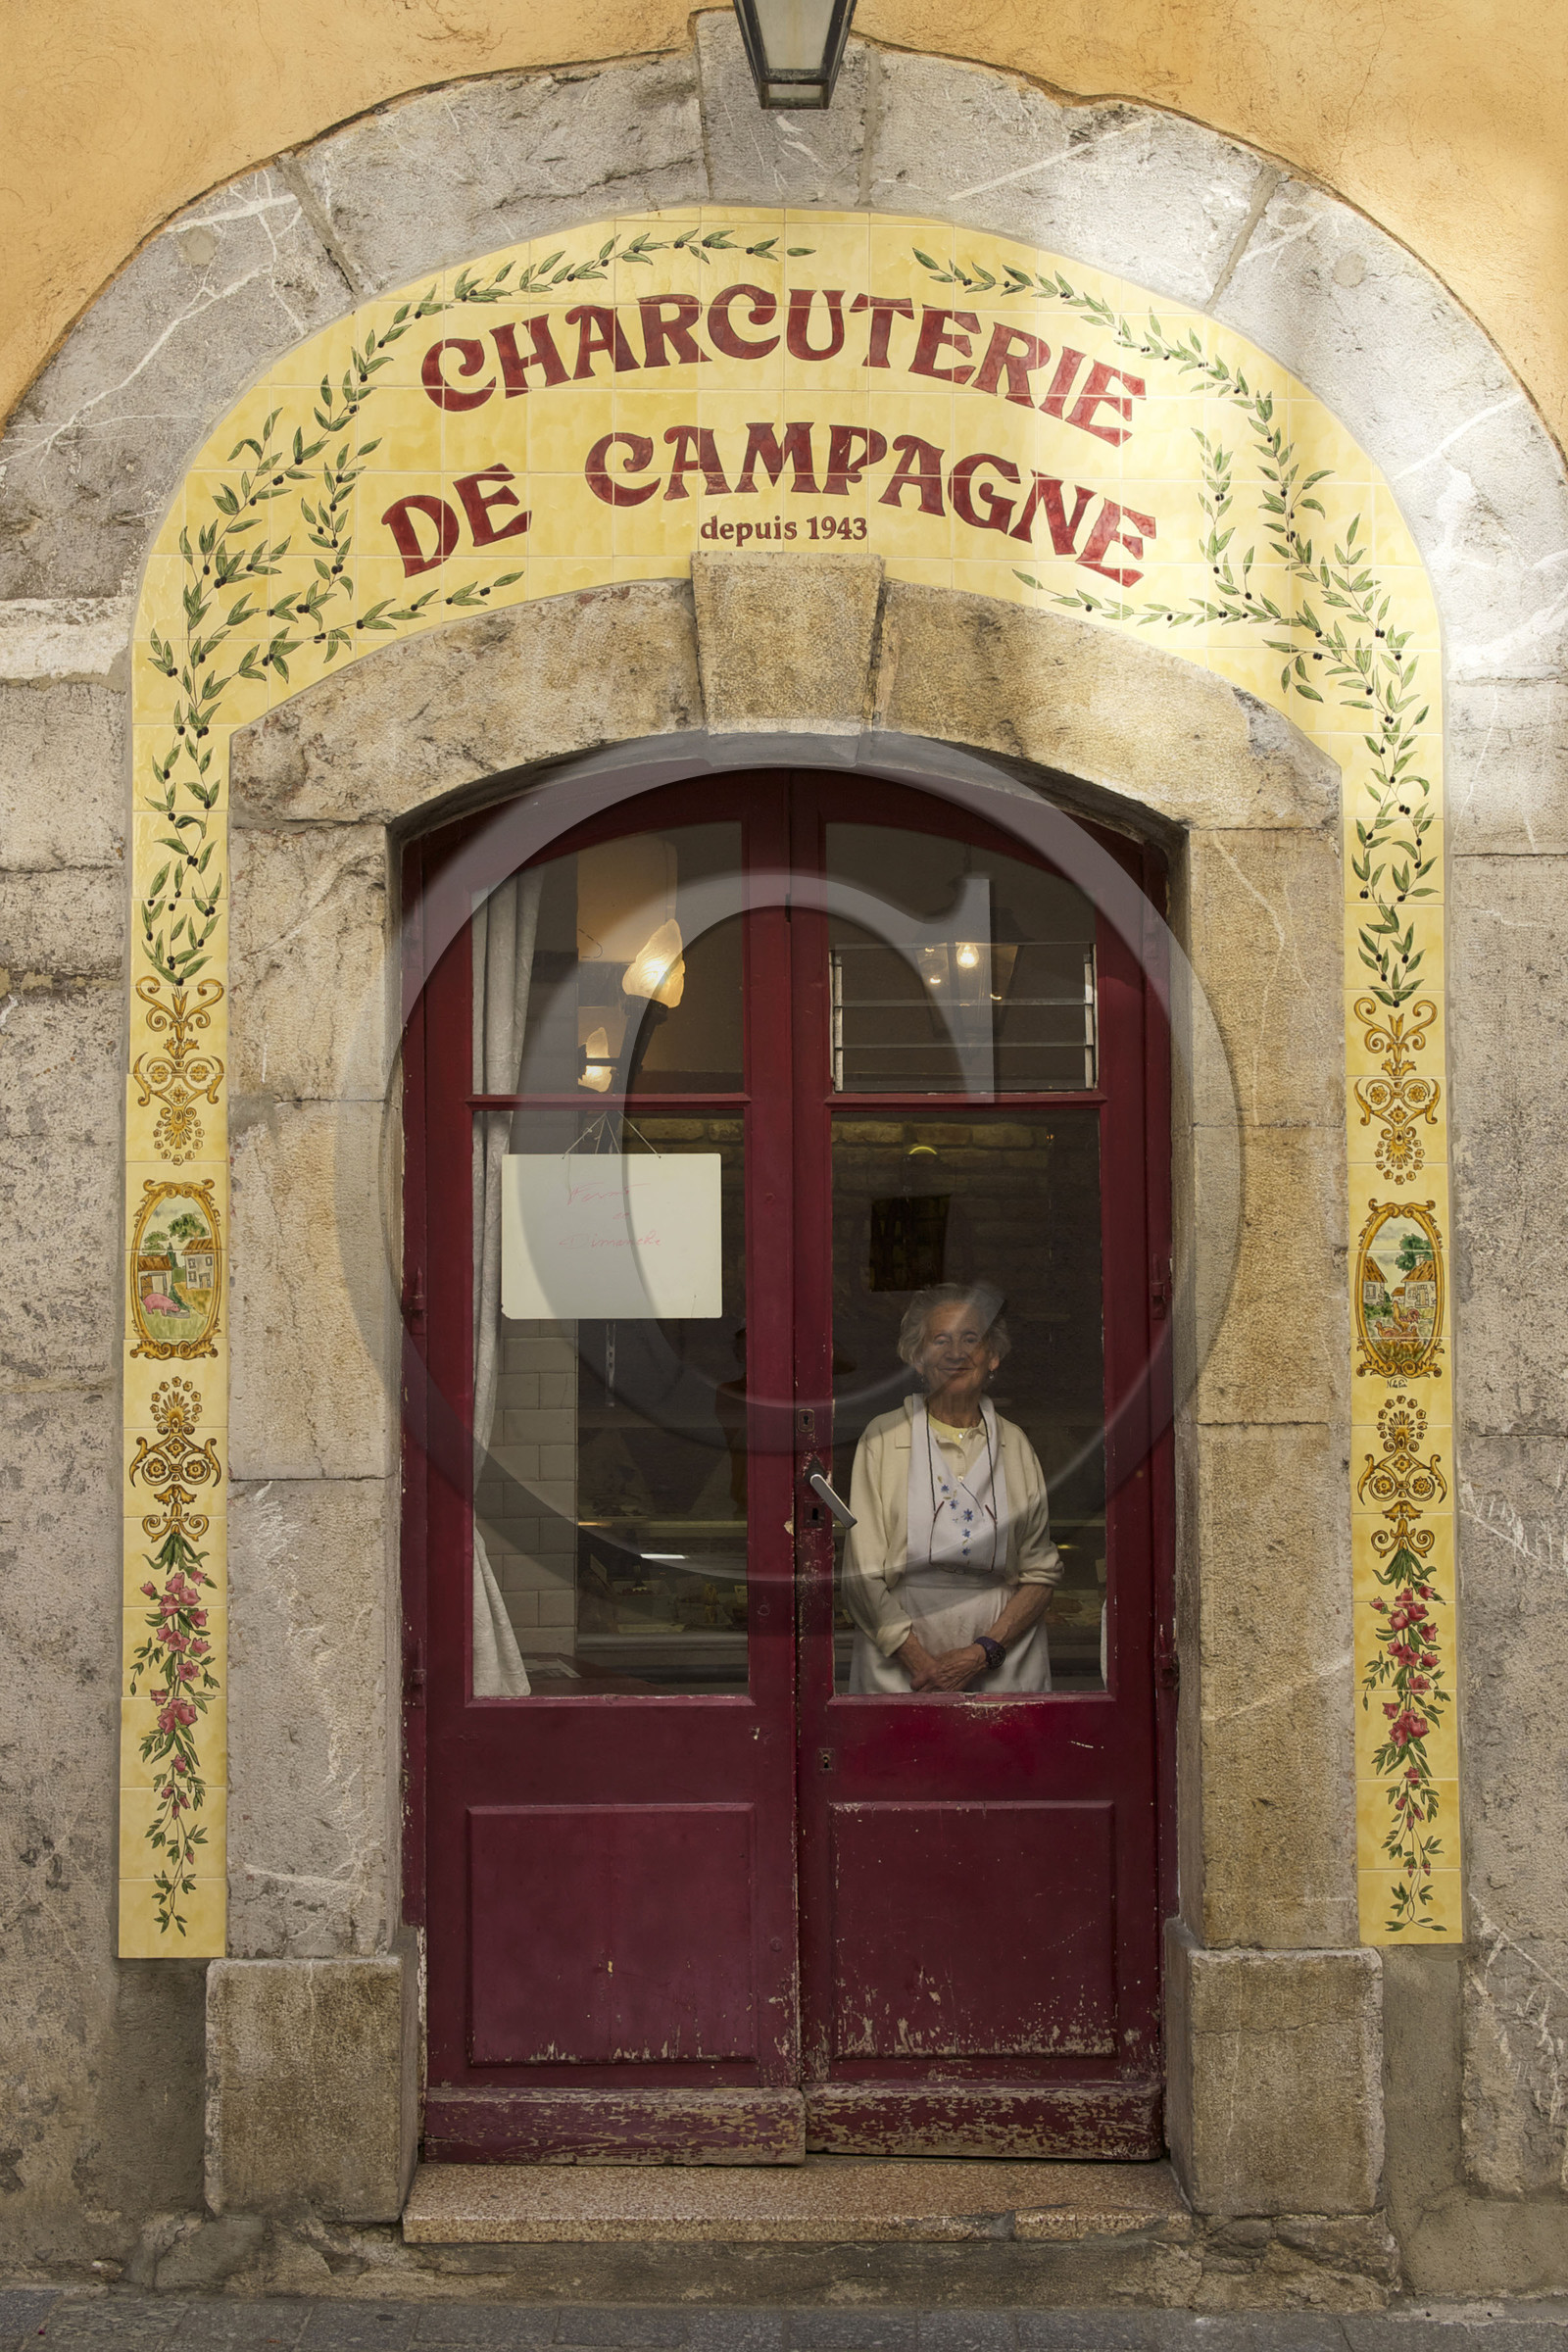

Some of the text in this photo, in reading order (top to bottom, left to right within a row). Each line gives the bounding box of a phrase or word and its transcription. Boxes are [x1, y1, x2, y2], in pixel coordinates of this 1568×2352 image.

[420, 283, 1147, 447] CHARCUTERIE
[380, 421, 1157, 588] DE CAMPAGNE
[700, 514, 868, 548] depuis 1943
